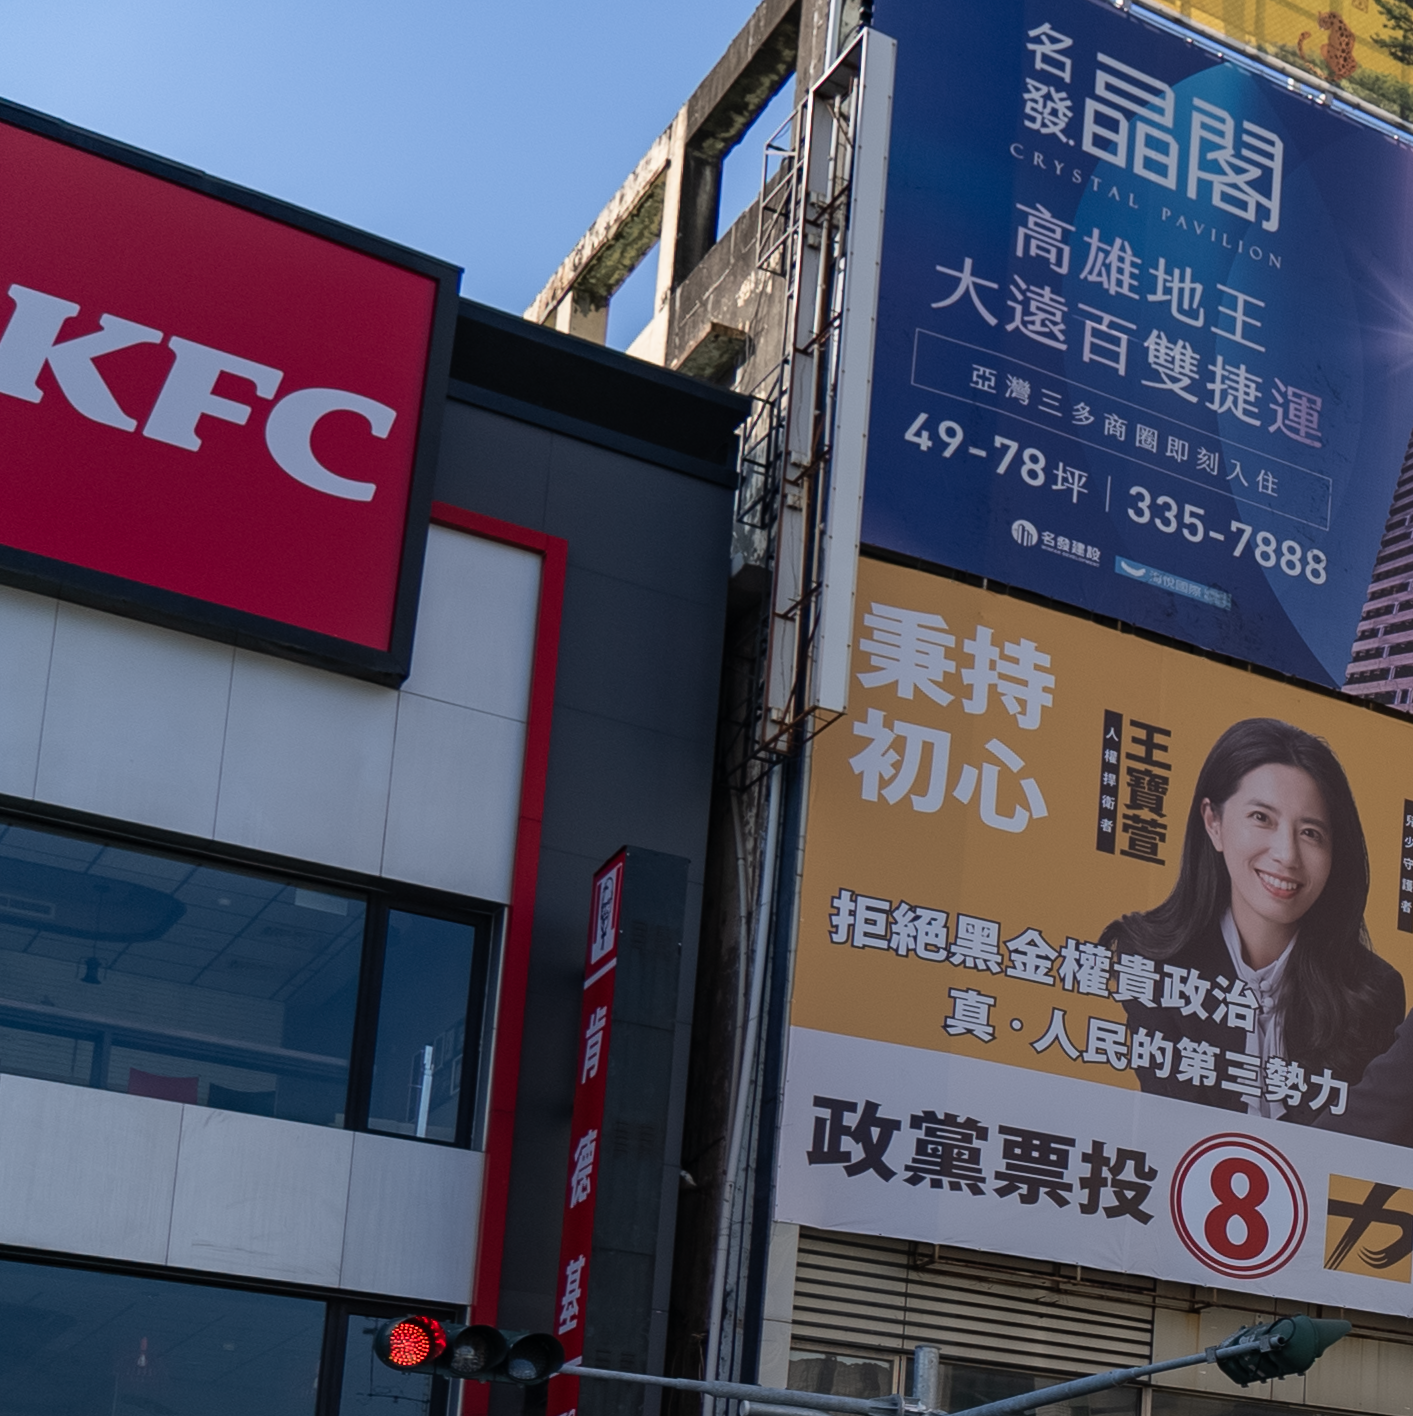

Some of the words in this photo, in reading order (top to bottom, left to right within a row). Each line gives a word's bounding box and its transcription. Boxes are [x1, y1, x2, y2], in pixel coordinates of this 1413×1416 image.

[1009, 142, 1139, 209] CRYSTAL
[1161, 206, 1283, 269] PAVILION
[1082, 52, 1284, 232] 晶閣
[1014, 202, 1266, 353] 高雄地王
[0, 284, 397, 502] KFC
[930, 256, 1323, 448] 大遠百雙捷運
[903, 411, 1089, 505] 49-78坪
[969, 363, 1280, 497] 亞灣三多商圈即刻入住
[1127, 485, 1327, 586] 335-7888
[856, 601, 1056, 730] 秉持
[848, 707, 1049, 833] 初心
[1100, 726, 1119, 834] 人權捍衛者
[1119, 718, 1172, 867] 王寶萱
[829, 888, 1260, 1032] 拒絕黑金權貴政治
[806, 1094, 1159, 1226] 政黨票投
[1204, 1156, 1271, 1261] 8
